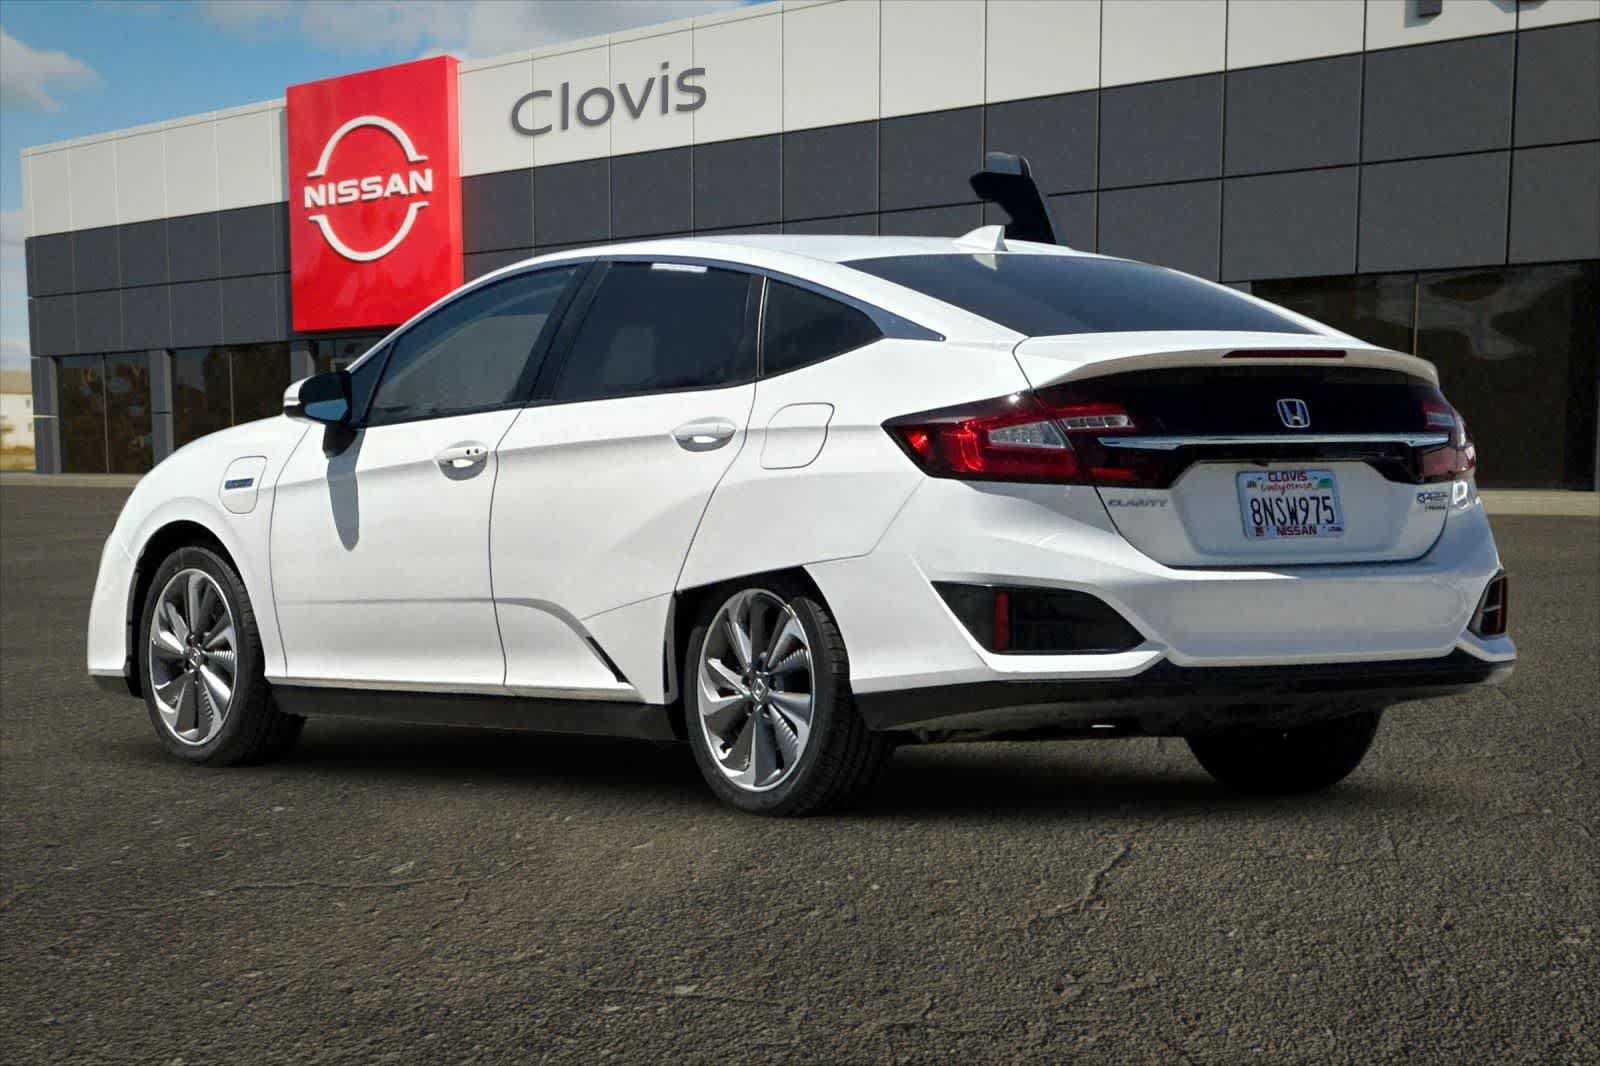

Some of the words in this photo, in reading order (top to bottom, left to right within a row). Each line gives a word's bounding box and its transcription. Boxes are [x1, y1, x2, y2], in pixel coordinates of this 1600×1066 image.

[511, 61, 707, 136] Clovis
[304, 168, 433, 208] NISSAN
[1268, 471, 1308, 482] CLOVIS
[1251, 496, 1335, 526] 8NSW975
[1277, 525, 1317, 536] NISSAN
